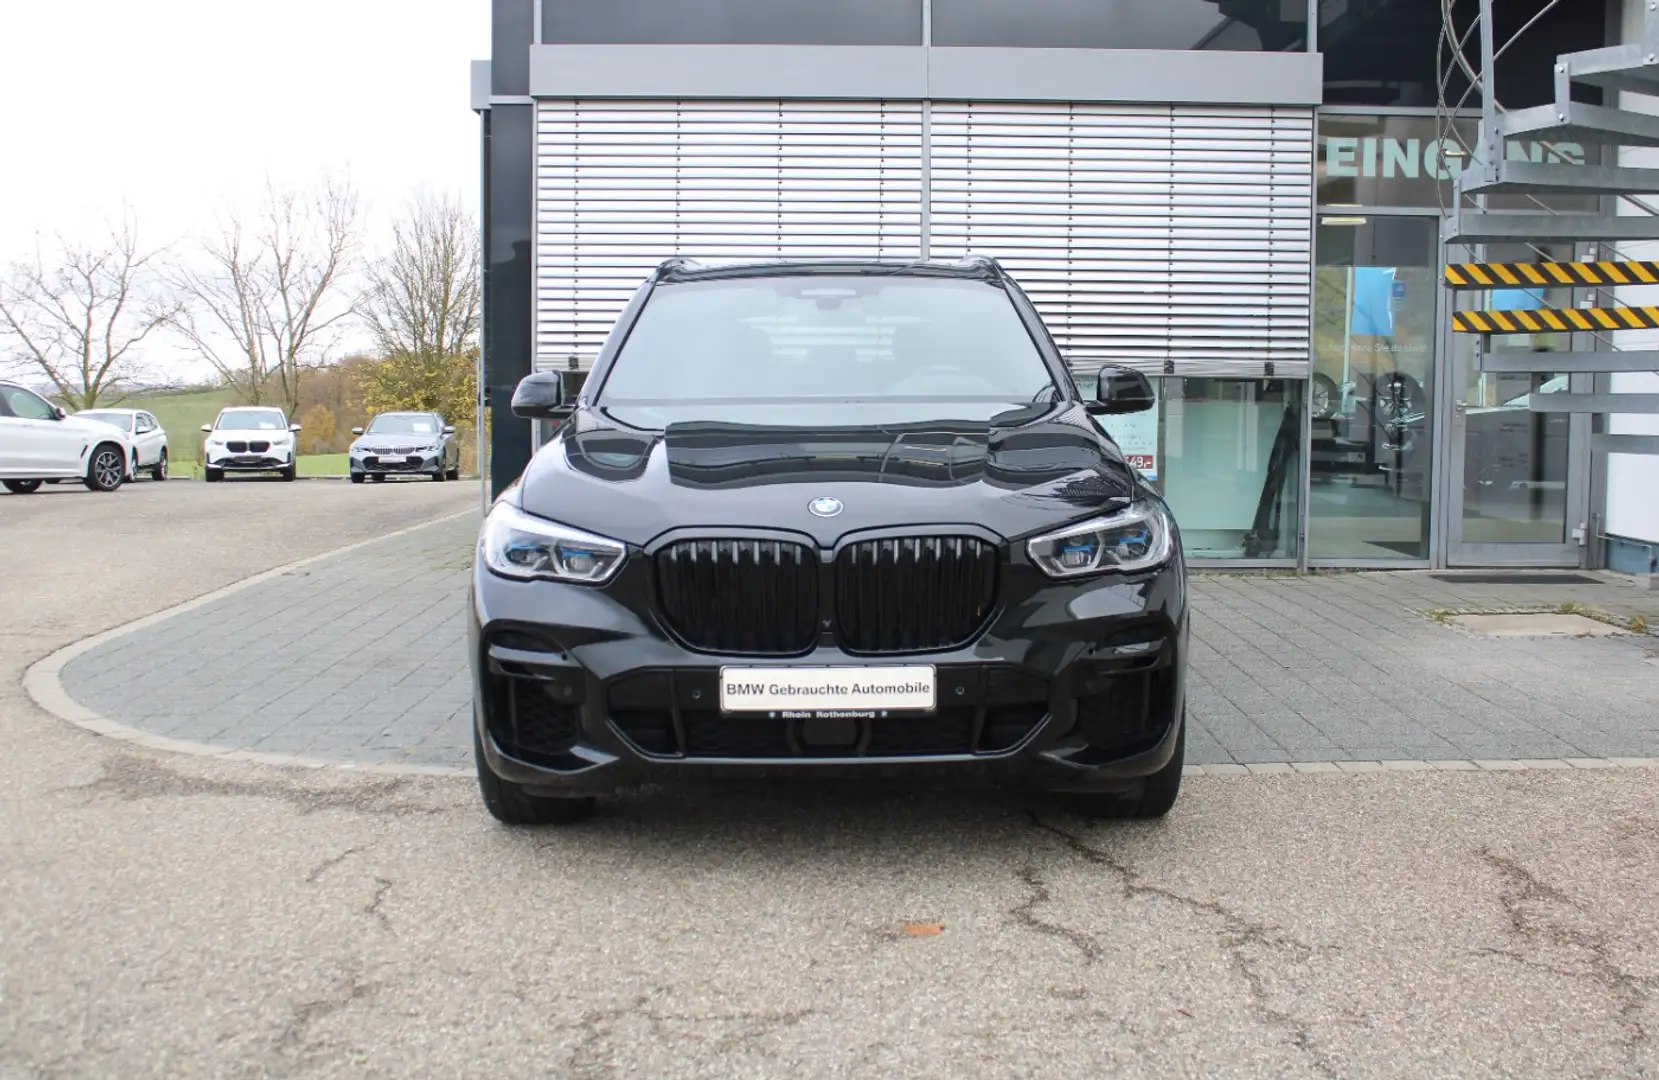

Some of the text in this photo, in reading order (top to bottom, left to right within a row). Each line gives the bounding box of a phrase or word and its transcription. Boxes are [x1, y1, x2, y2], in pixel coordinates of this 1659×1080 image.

[1326, 137, 1585, 180] EINGNG
[726, 682, 930, 696] BMW Gebrauchte Automobile
[816, 710, 875, 719] Rothenburg
